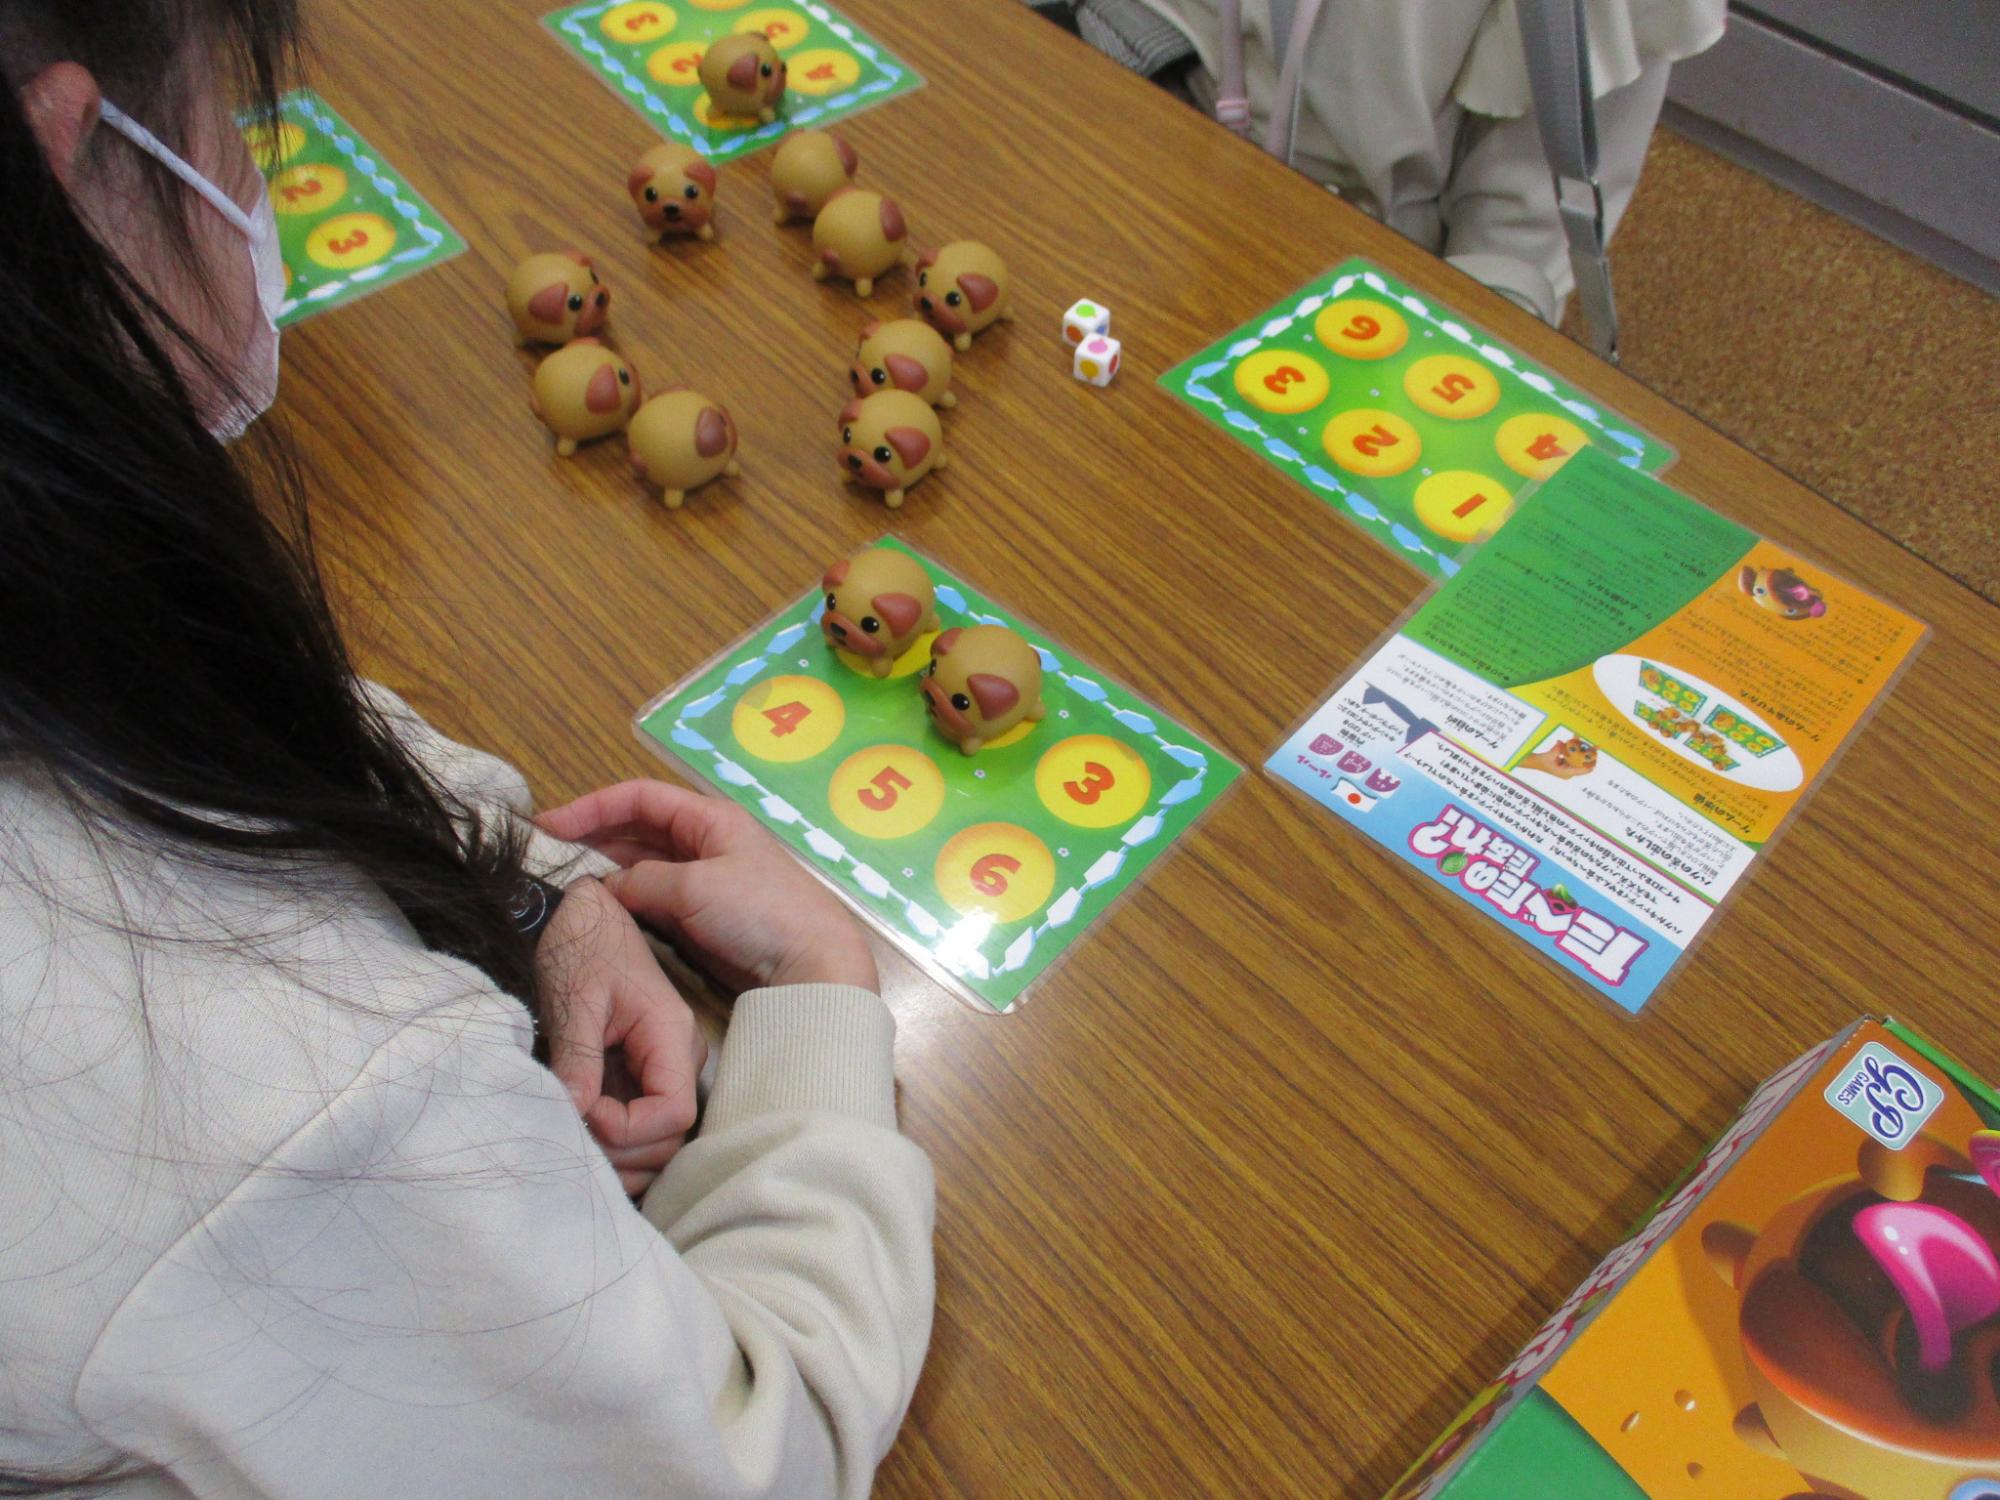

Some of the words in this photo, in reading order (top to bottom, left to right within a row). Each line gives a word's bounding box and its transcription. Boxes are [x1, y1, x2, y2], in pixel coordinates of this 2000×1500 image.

[625, 12, 658, 31] 3
[671, 53, 704, 73] 2
[282, 179, 322, 203] 2
[328, 229, 368, 254] 3
[1341, 314, 1381, 340] 6
[1263, 365, 1306, 394] 3
[1431, 373, 1475, 404] 5
[1353, 424, 1400, 457] 2
[1525, 432, 1570, 461] 4
[1452, 493, 1488, 519] 1
[760, 699, 812, 738] 4
[1293, 753, 1332, 781] ルール
[856, 765, 913, 812] 5
[1062, 761, 1115, 805] 3
[968, 852, 1023, 897] 6
[1837, 1071, 1869, 1105] GAMES
